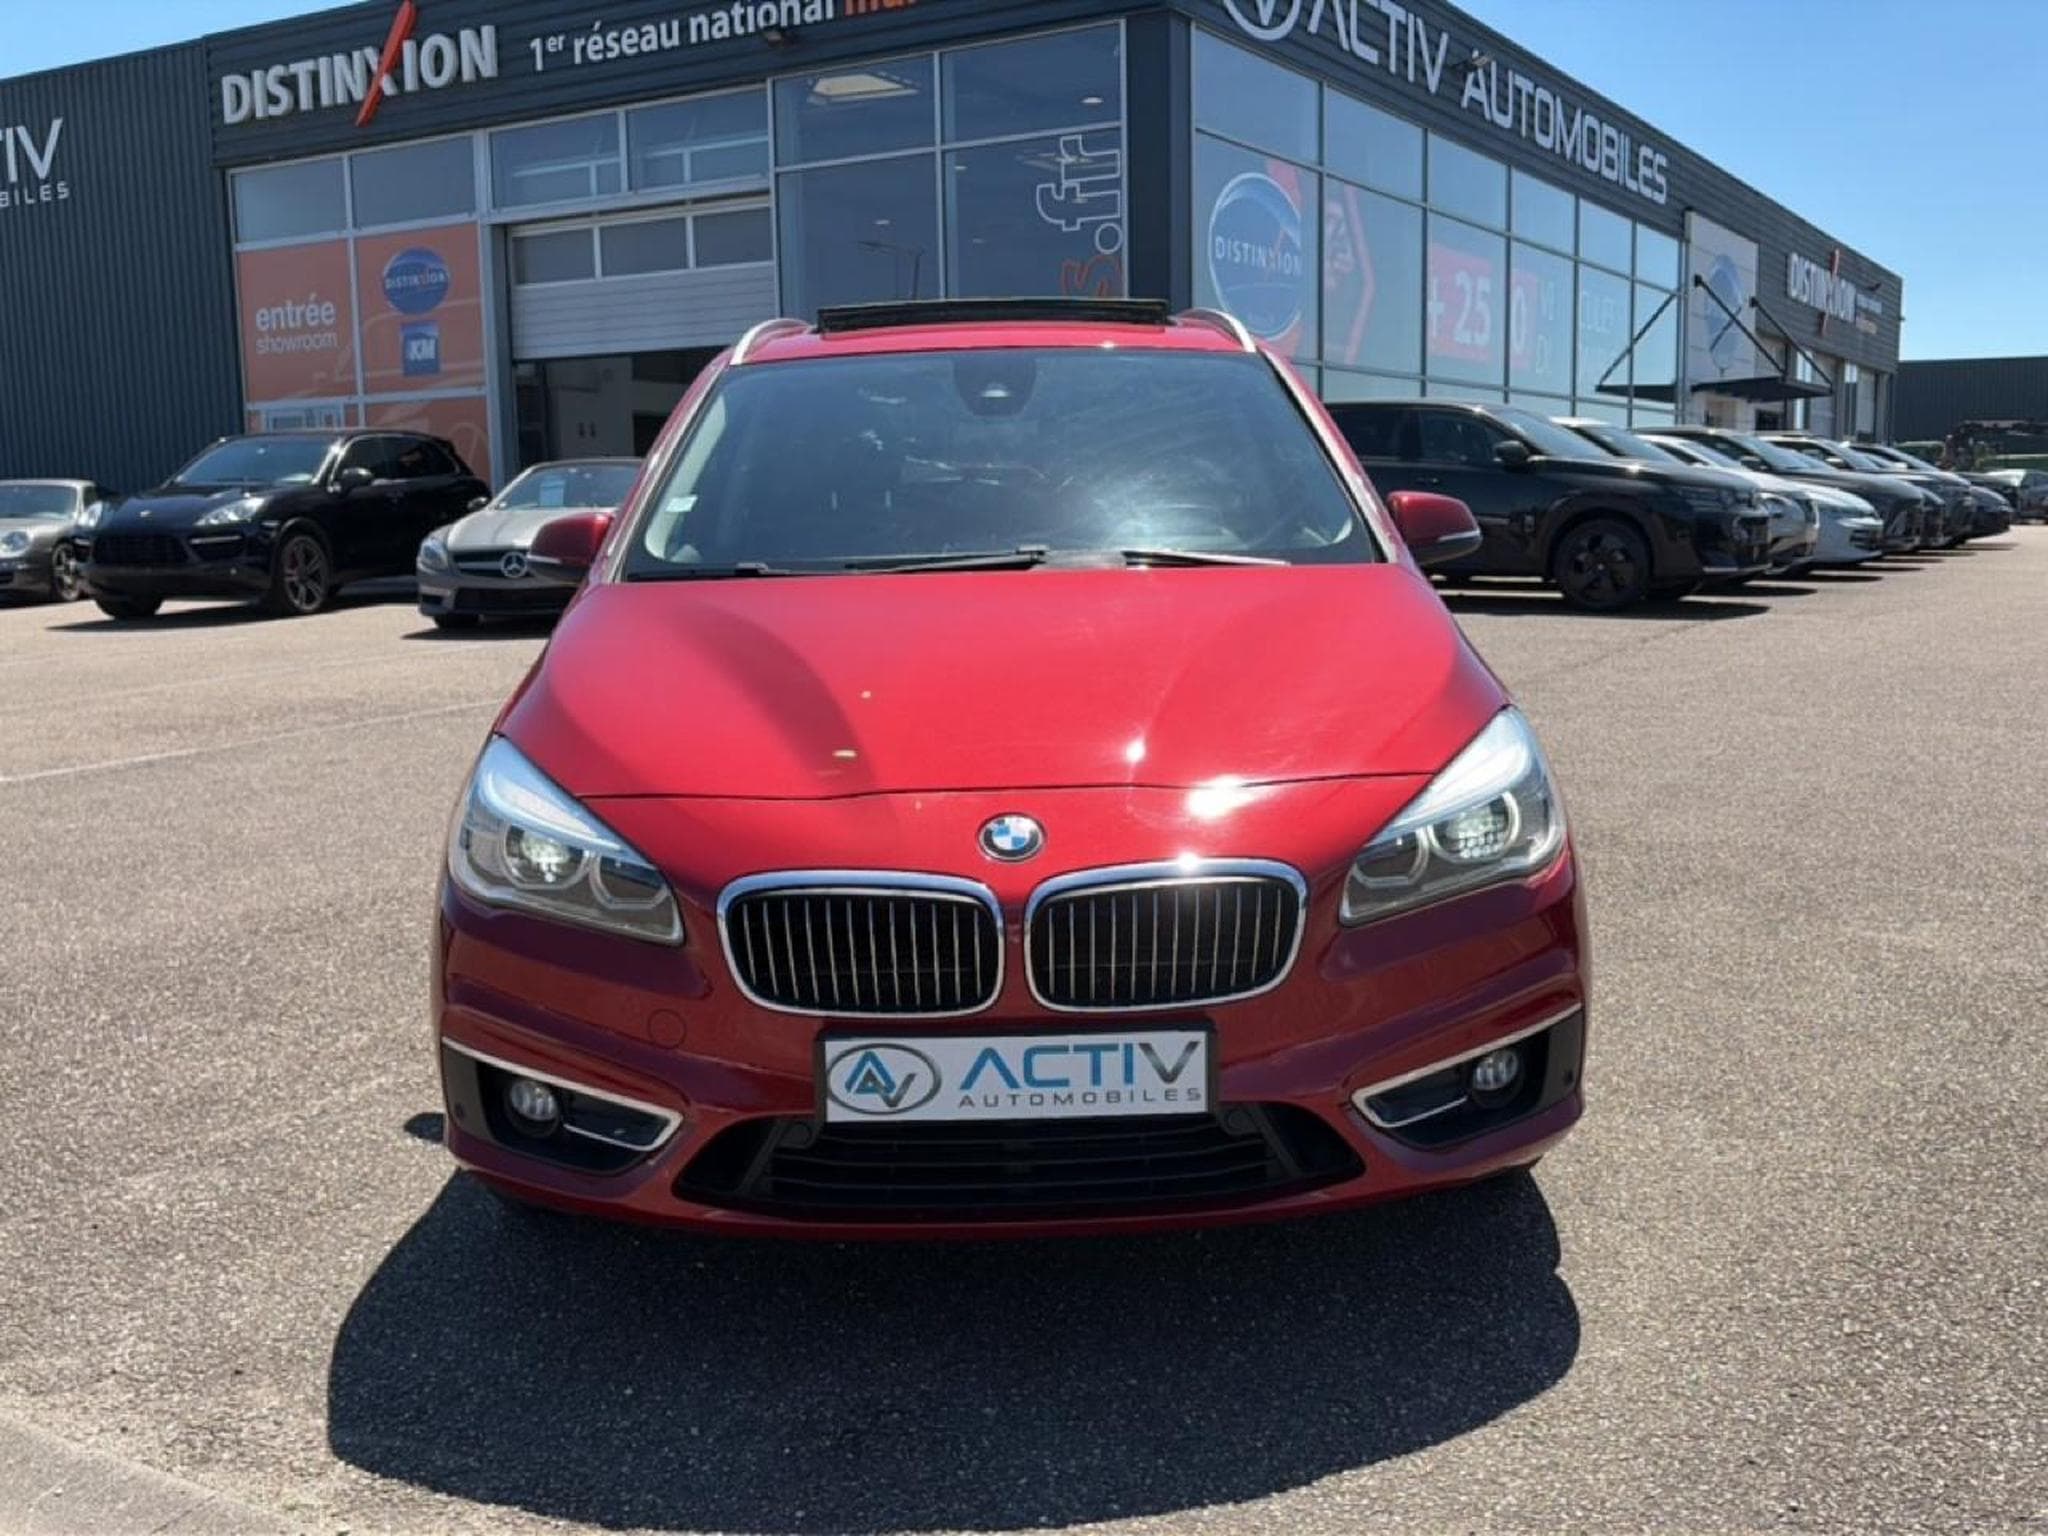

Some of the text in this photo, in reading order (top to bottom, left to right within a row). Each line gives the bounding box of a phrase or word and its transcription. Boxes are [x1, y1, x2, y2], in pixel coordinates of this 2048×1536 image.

[530, 34, 565, 71] 1er
[573, 20, 679, 64] réseau
[0, 117, 63, 182] IV
[1460, 49, 1667, 205] AUTOMOBILES
[256, 292, 336, 332] entrée
[256, 333, 338, 355] showroom
[960, 1041, 1199, 1090] ACTIV
[958, 1087, 1202, 1108] AUTOMOBILES
